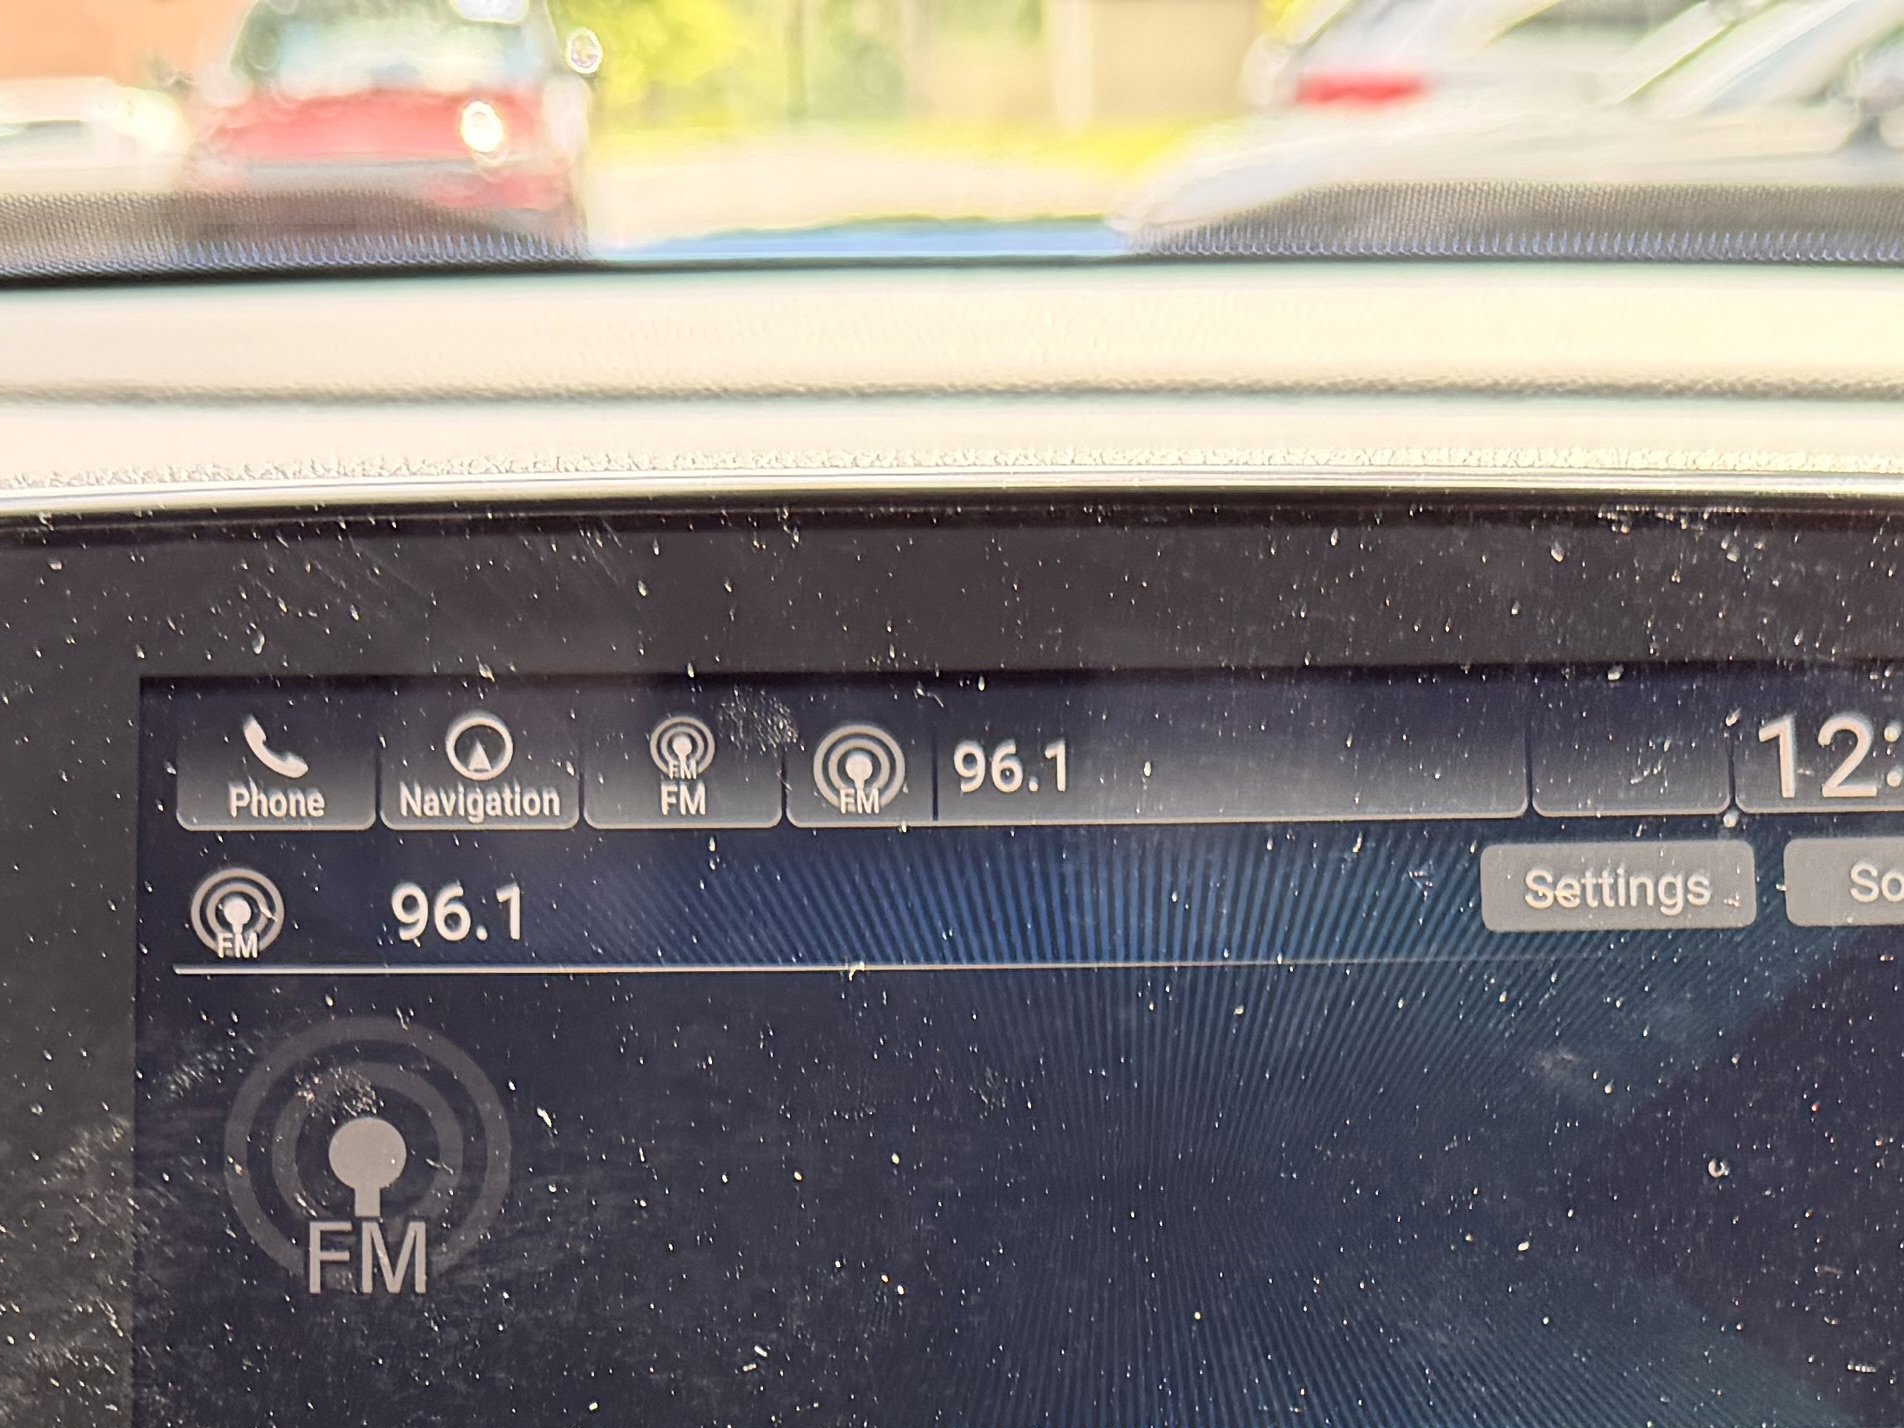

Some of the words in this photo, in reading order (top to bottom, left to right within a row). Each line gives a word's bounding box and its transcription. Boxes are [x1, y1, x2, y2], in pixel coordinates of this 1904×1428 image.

[953, 738, 1067, 793] 96.1
[229, 782, 325, 818] Phone
[399, 781, 560, 824] Navigation
[660, 783, 706, 815] FM
[839, 788, 880, 814] FM
[391, 882, 524, 942] 96.1
[1525, 867, 1711, 915] Settings
[217, 932, 259, 959] FM
[308, 1221, 427, 1294] FM
